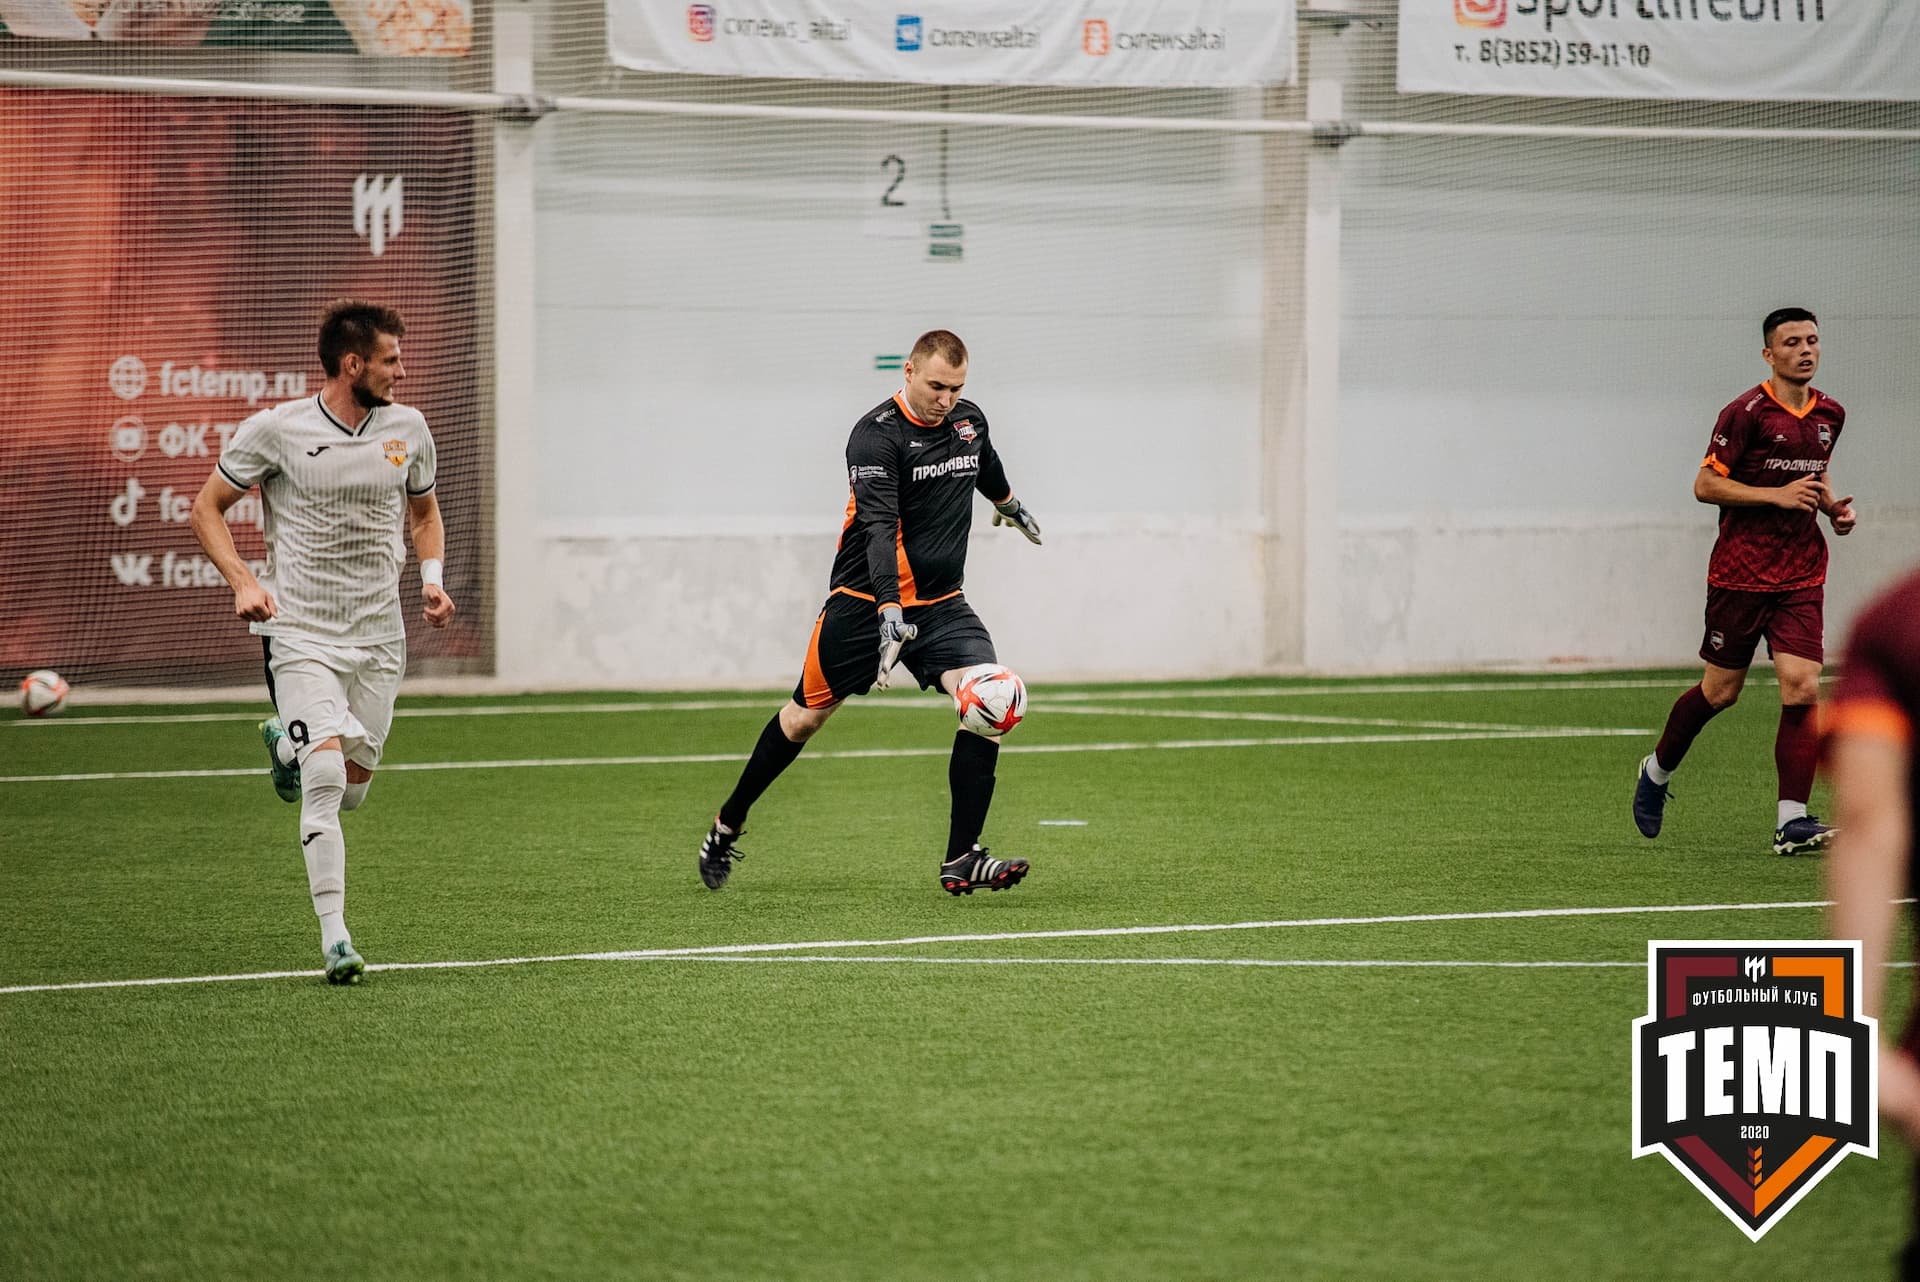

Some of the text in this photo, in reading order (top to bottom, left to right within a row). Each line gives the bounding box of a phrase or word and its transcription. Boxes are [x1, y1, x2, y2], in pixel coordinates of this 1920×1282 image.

[928, 25, 1040, 49] cxnewsaltai
[1115, 26, 1226, 51] cxnewsaltai
[881, 154, 907, 207] 2
[160, 361, 307, 406] fctemp.ru
[158, 422, 209, 459] ФК
[288, 719, 310, 752] 9
